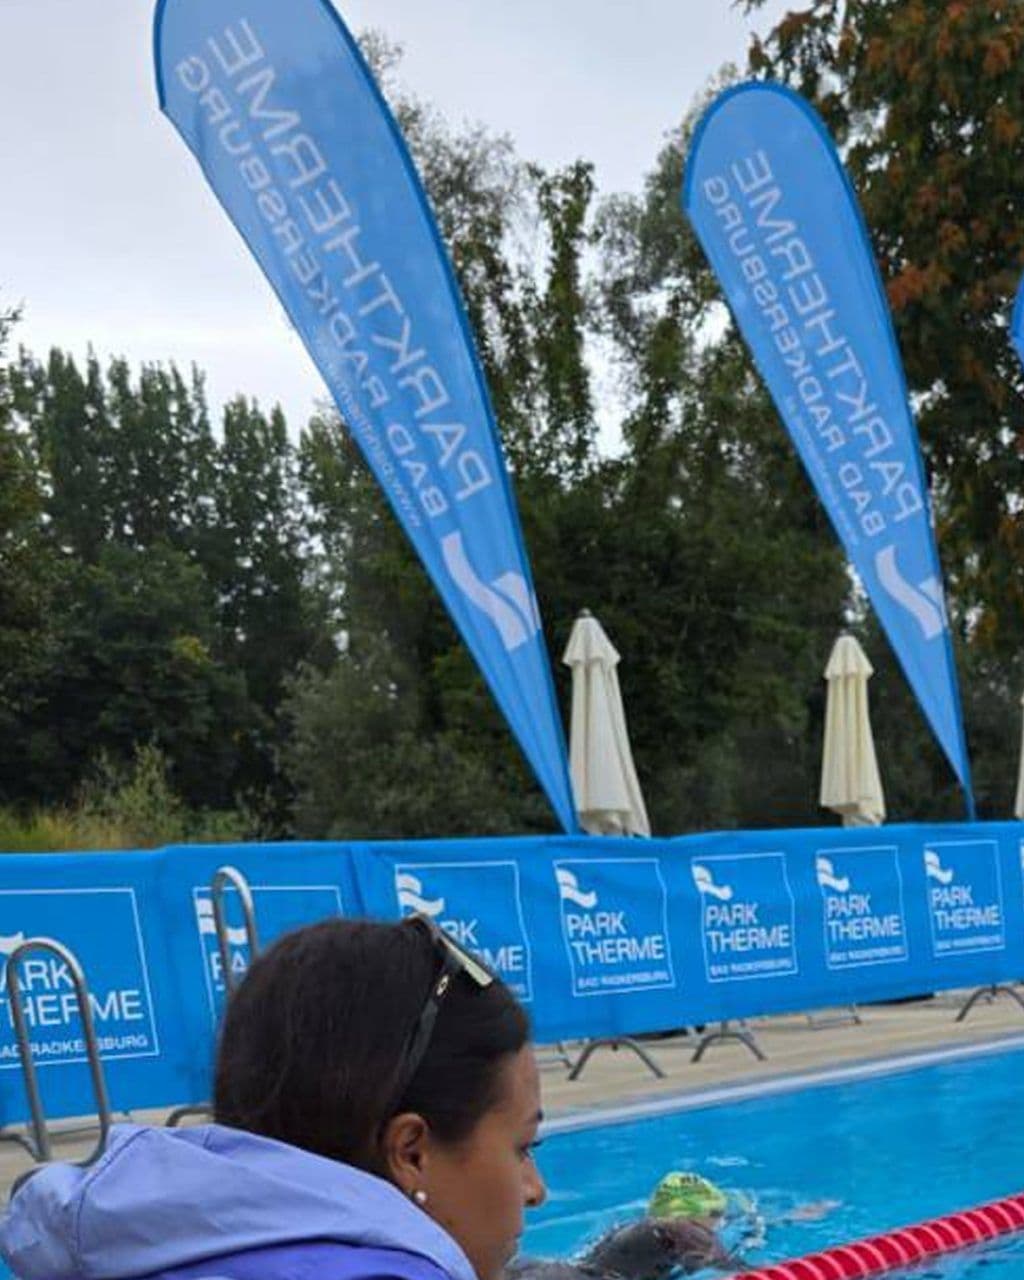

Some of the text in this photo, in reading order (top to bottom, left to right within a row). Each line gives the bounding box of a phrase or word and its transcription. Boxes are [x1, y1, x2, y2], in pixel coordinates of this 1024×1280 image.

[827, 893, 872, 918] PARK
[932, 884, 974, 909] PARK
[566, 911, 627, 938] PARK
[706, 902, 759, 928] PARK
[827, 914, 901, 942] THERME
[934, 904, 1000, 931] THERME
[571, 935, 665, 966] THERME
[706, 924, 790, 954] THERME
[29, 1033, 148, 1056] RADKESBURG
